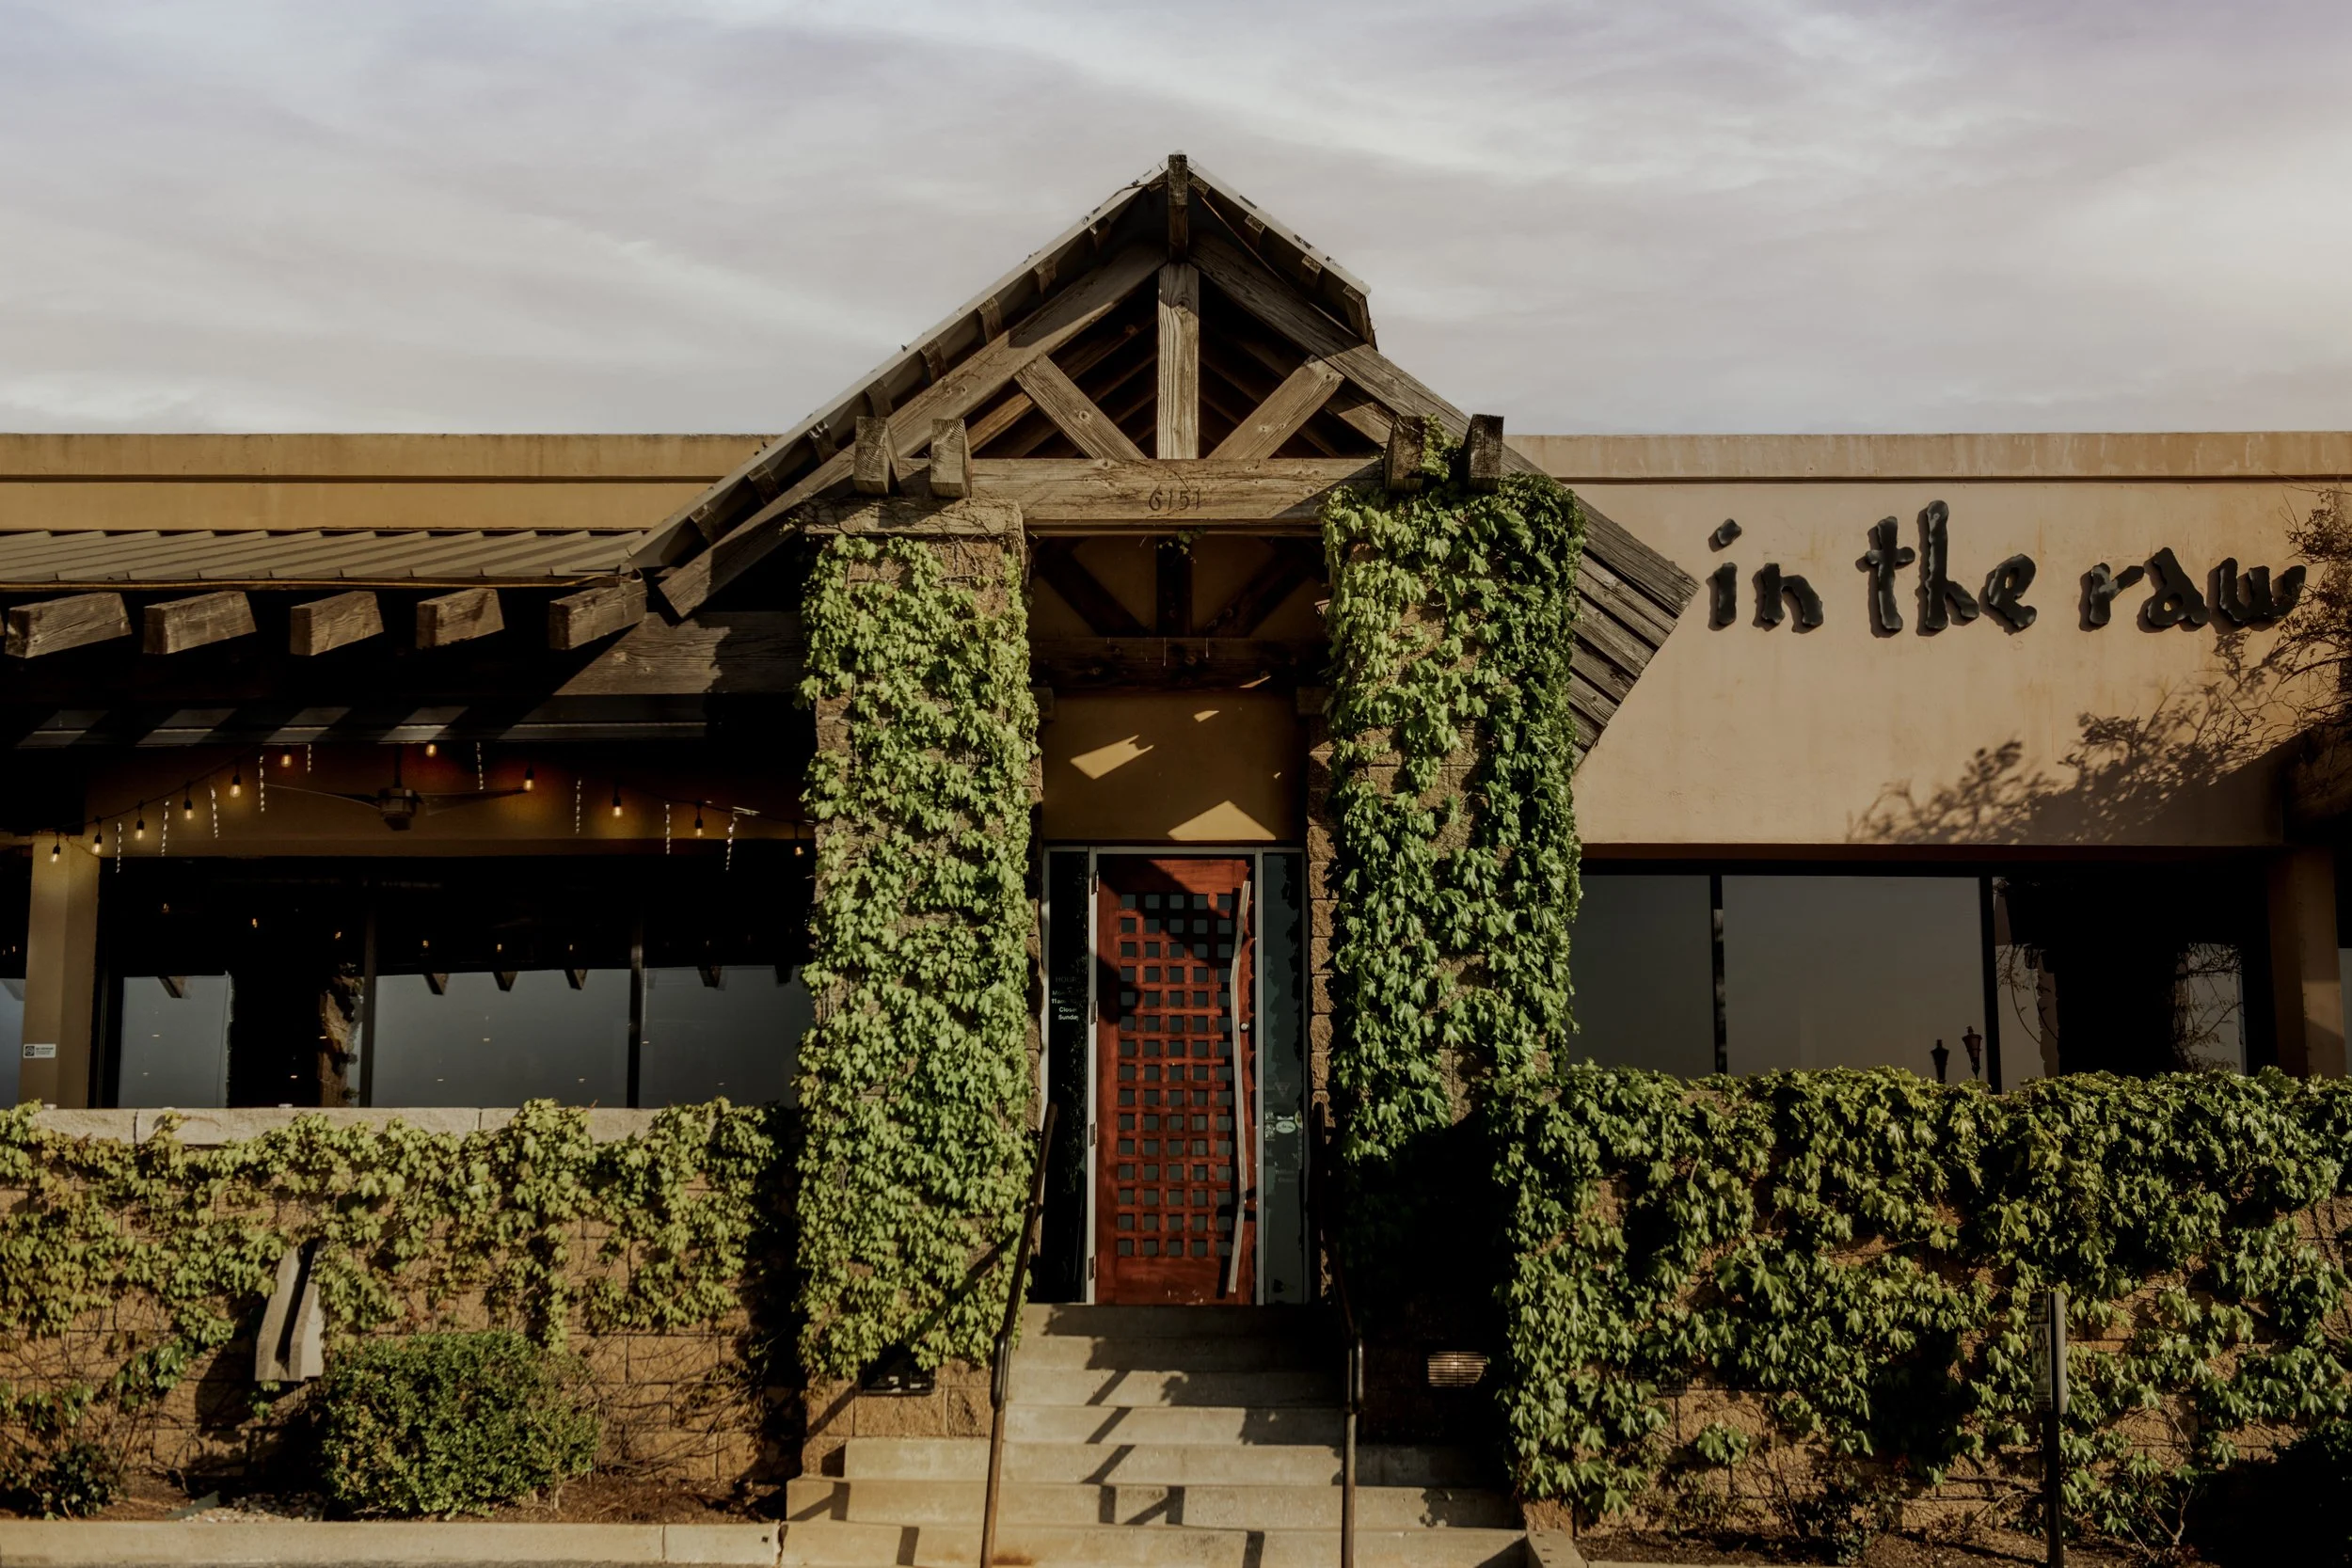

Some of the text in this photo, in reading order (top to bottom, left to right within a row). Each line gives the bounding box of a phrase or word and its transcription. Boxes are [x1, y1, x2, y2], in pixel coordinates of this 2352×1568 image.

[1149, 485, 1201, 512] 6151
[1713, 499, 2307, 632] in the raw
